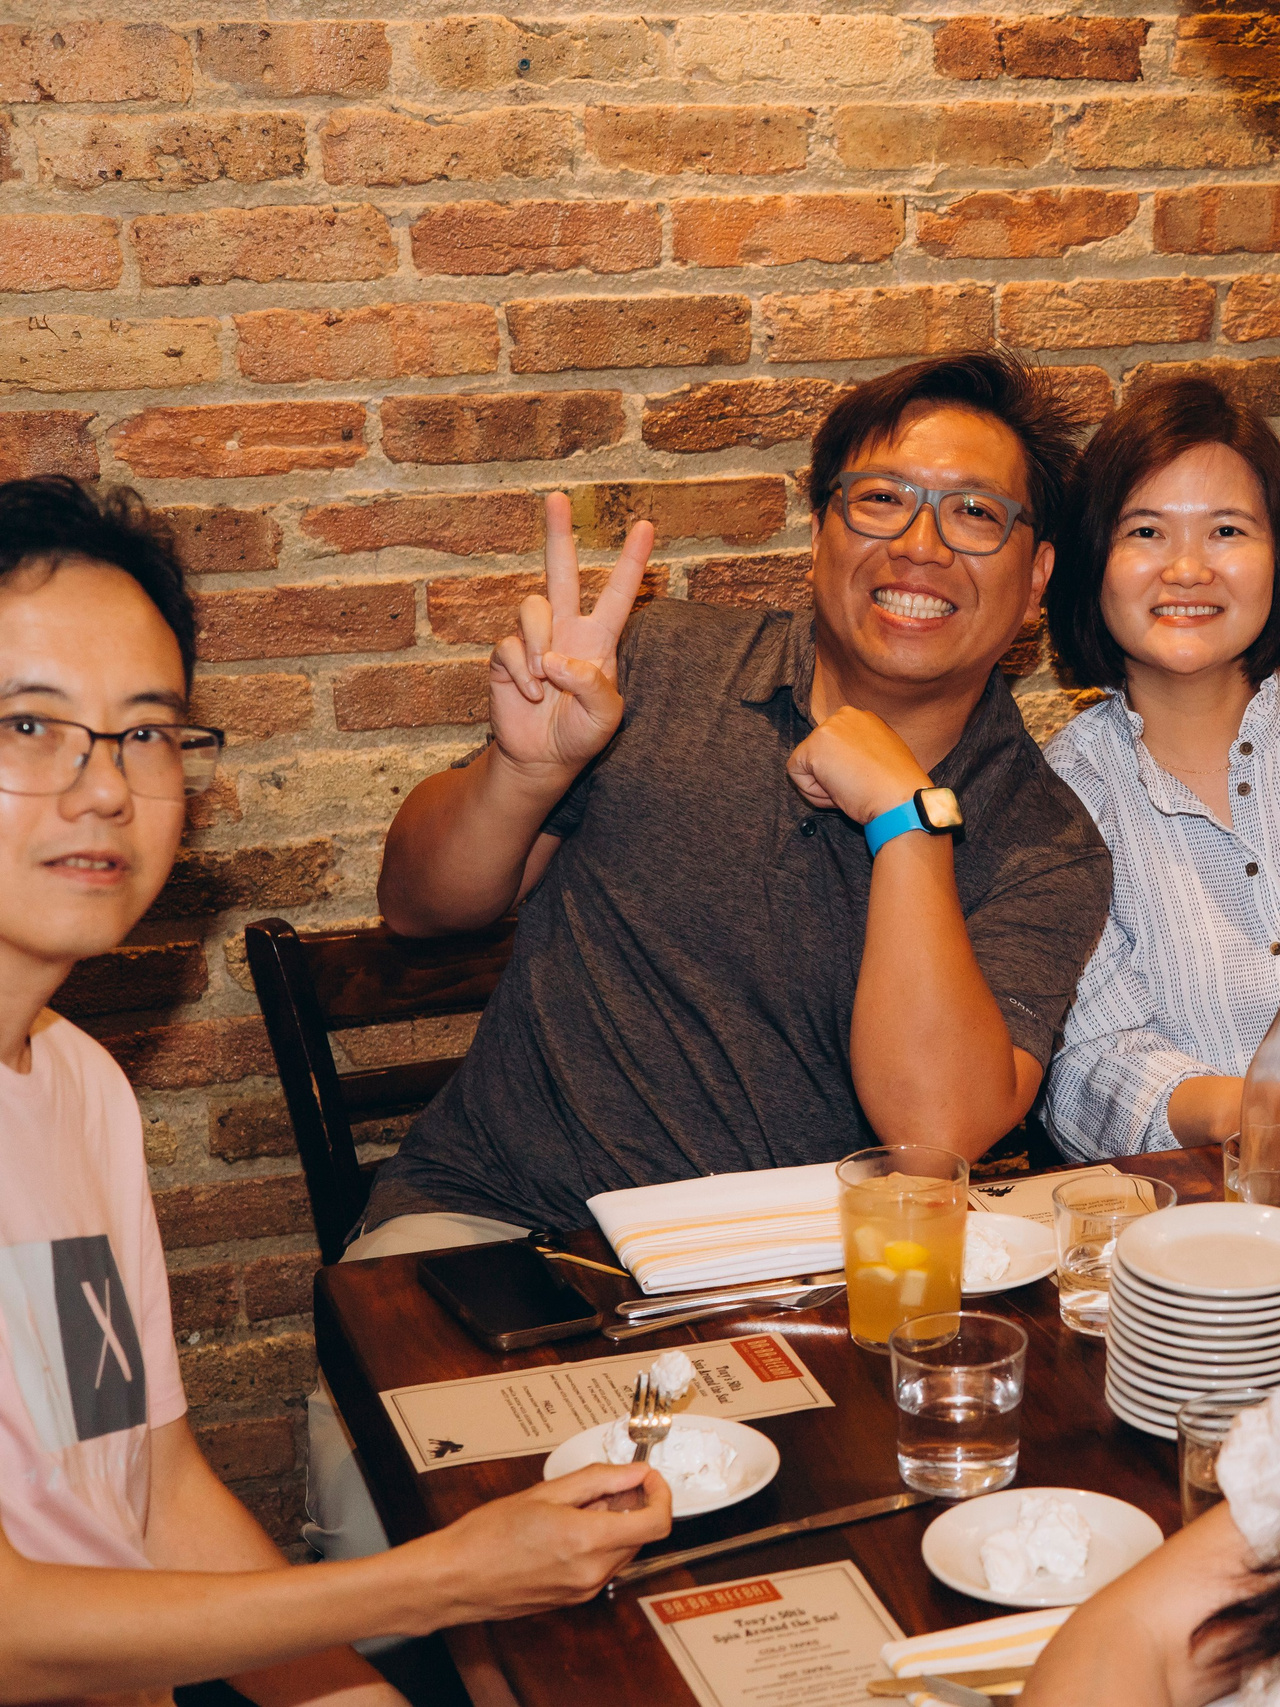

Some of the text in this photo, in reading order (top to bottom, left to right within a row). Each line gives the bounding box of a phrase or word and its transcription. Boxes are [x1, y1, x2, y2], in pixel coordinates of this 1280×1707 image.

[699, 1368, 720, 1386] Around
[734, 1613, 776, 1628] Tony's
[713, 1632, 741, 1644] Spin
[745, 1621, 788, 1637] Around
[790, 1617, 811, 1628] the
